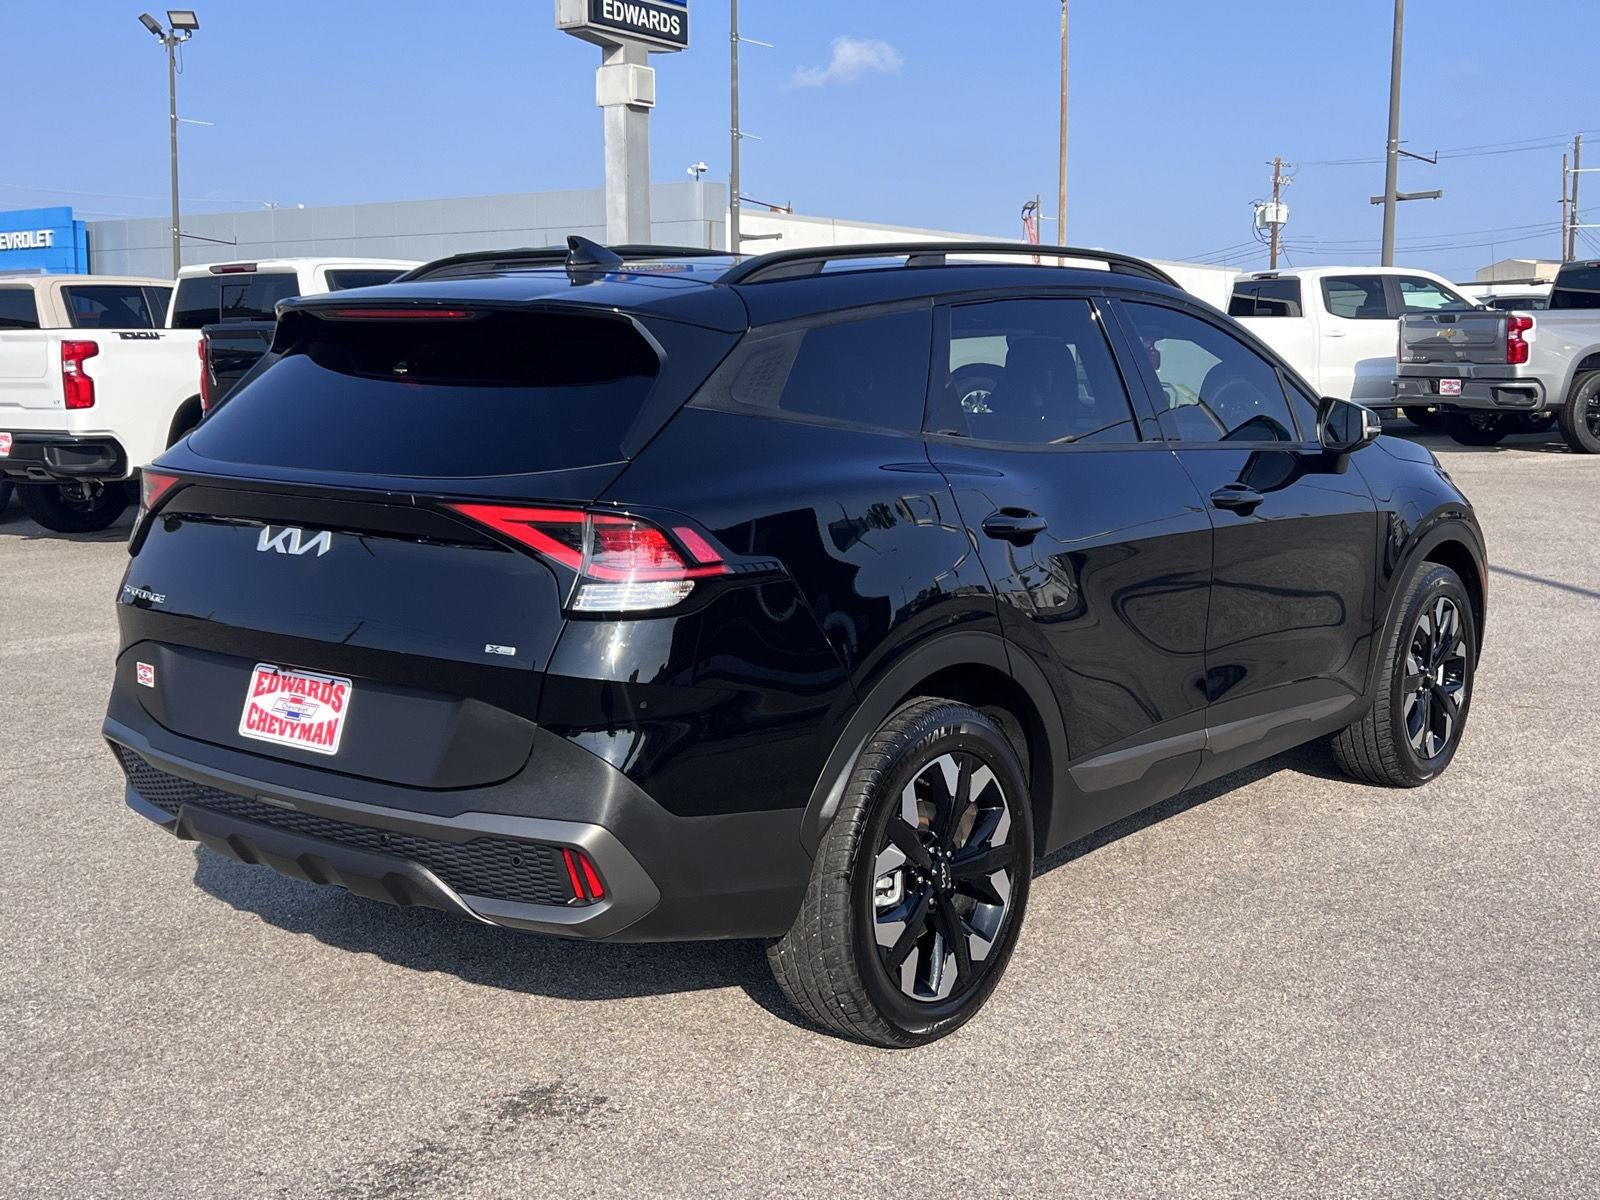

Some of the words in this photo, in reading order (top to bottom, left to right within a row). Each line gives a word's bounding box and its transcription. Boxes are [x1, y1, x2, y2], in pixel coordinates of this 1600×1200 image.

[603, 0, 680, 35] EDWARDS
[256, 525, 332, 557] KIA
[253, 671, 346, 713] EDWARDS
[246, 702, 339, 746] CHEVYMAN
